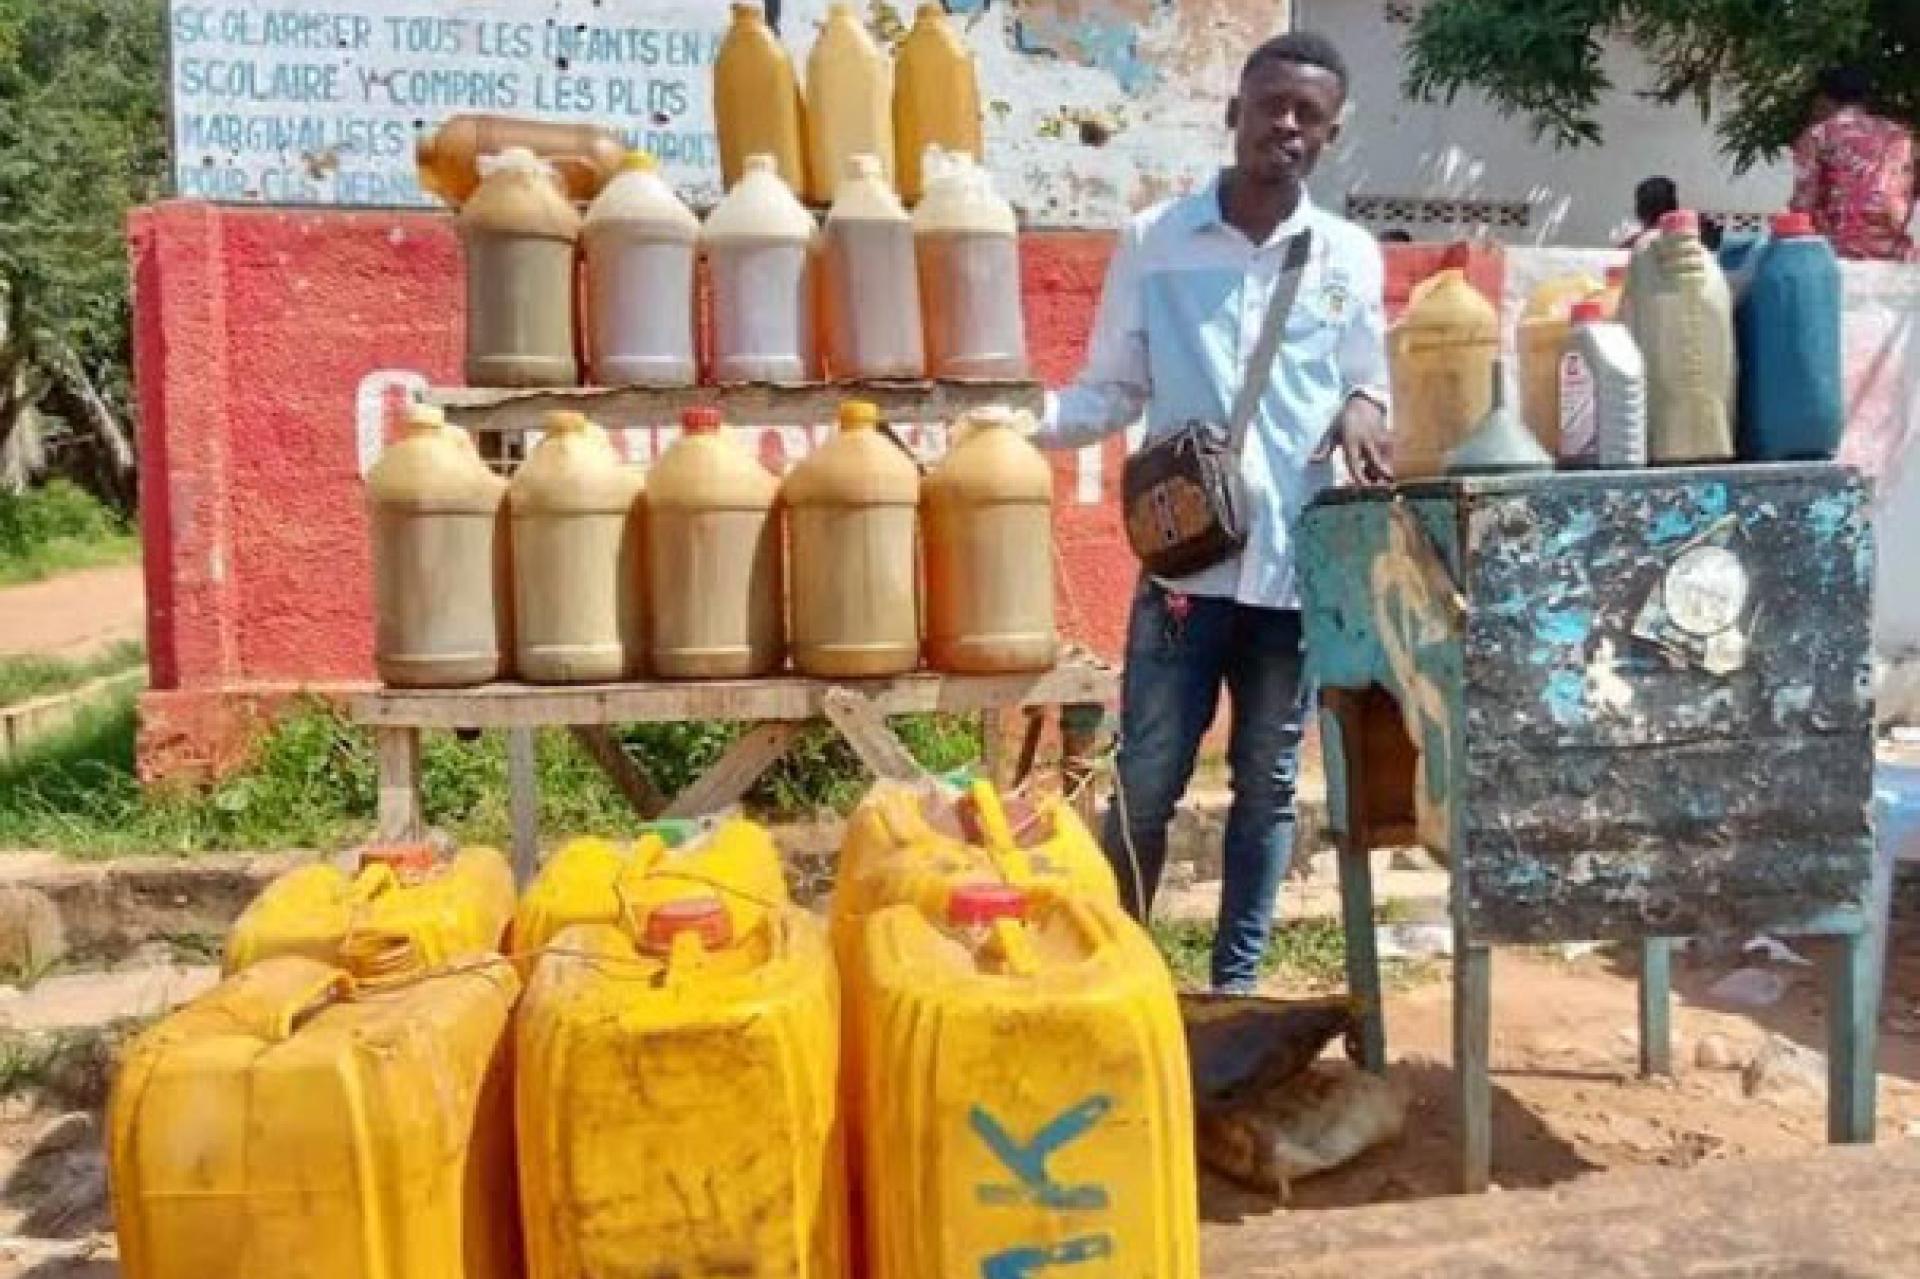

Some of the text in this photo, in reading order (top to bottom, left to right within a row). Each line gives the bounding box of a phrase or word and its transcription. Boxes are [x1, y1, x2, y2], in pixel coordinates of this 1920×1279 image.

[384, 16, 463, 54] TOUS
[477, 22, 534, 58] LES
[666, 32, 699, 65] EN
[181, 58, 342, 102] SCOLAIRE
[387, 68, 520, 109] COMPRIS
[535, 74, 595, 112] LES
